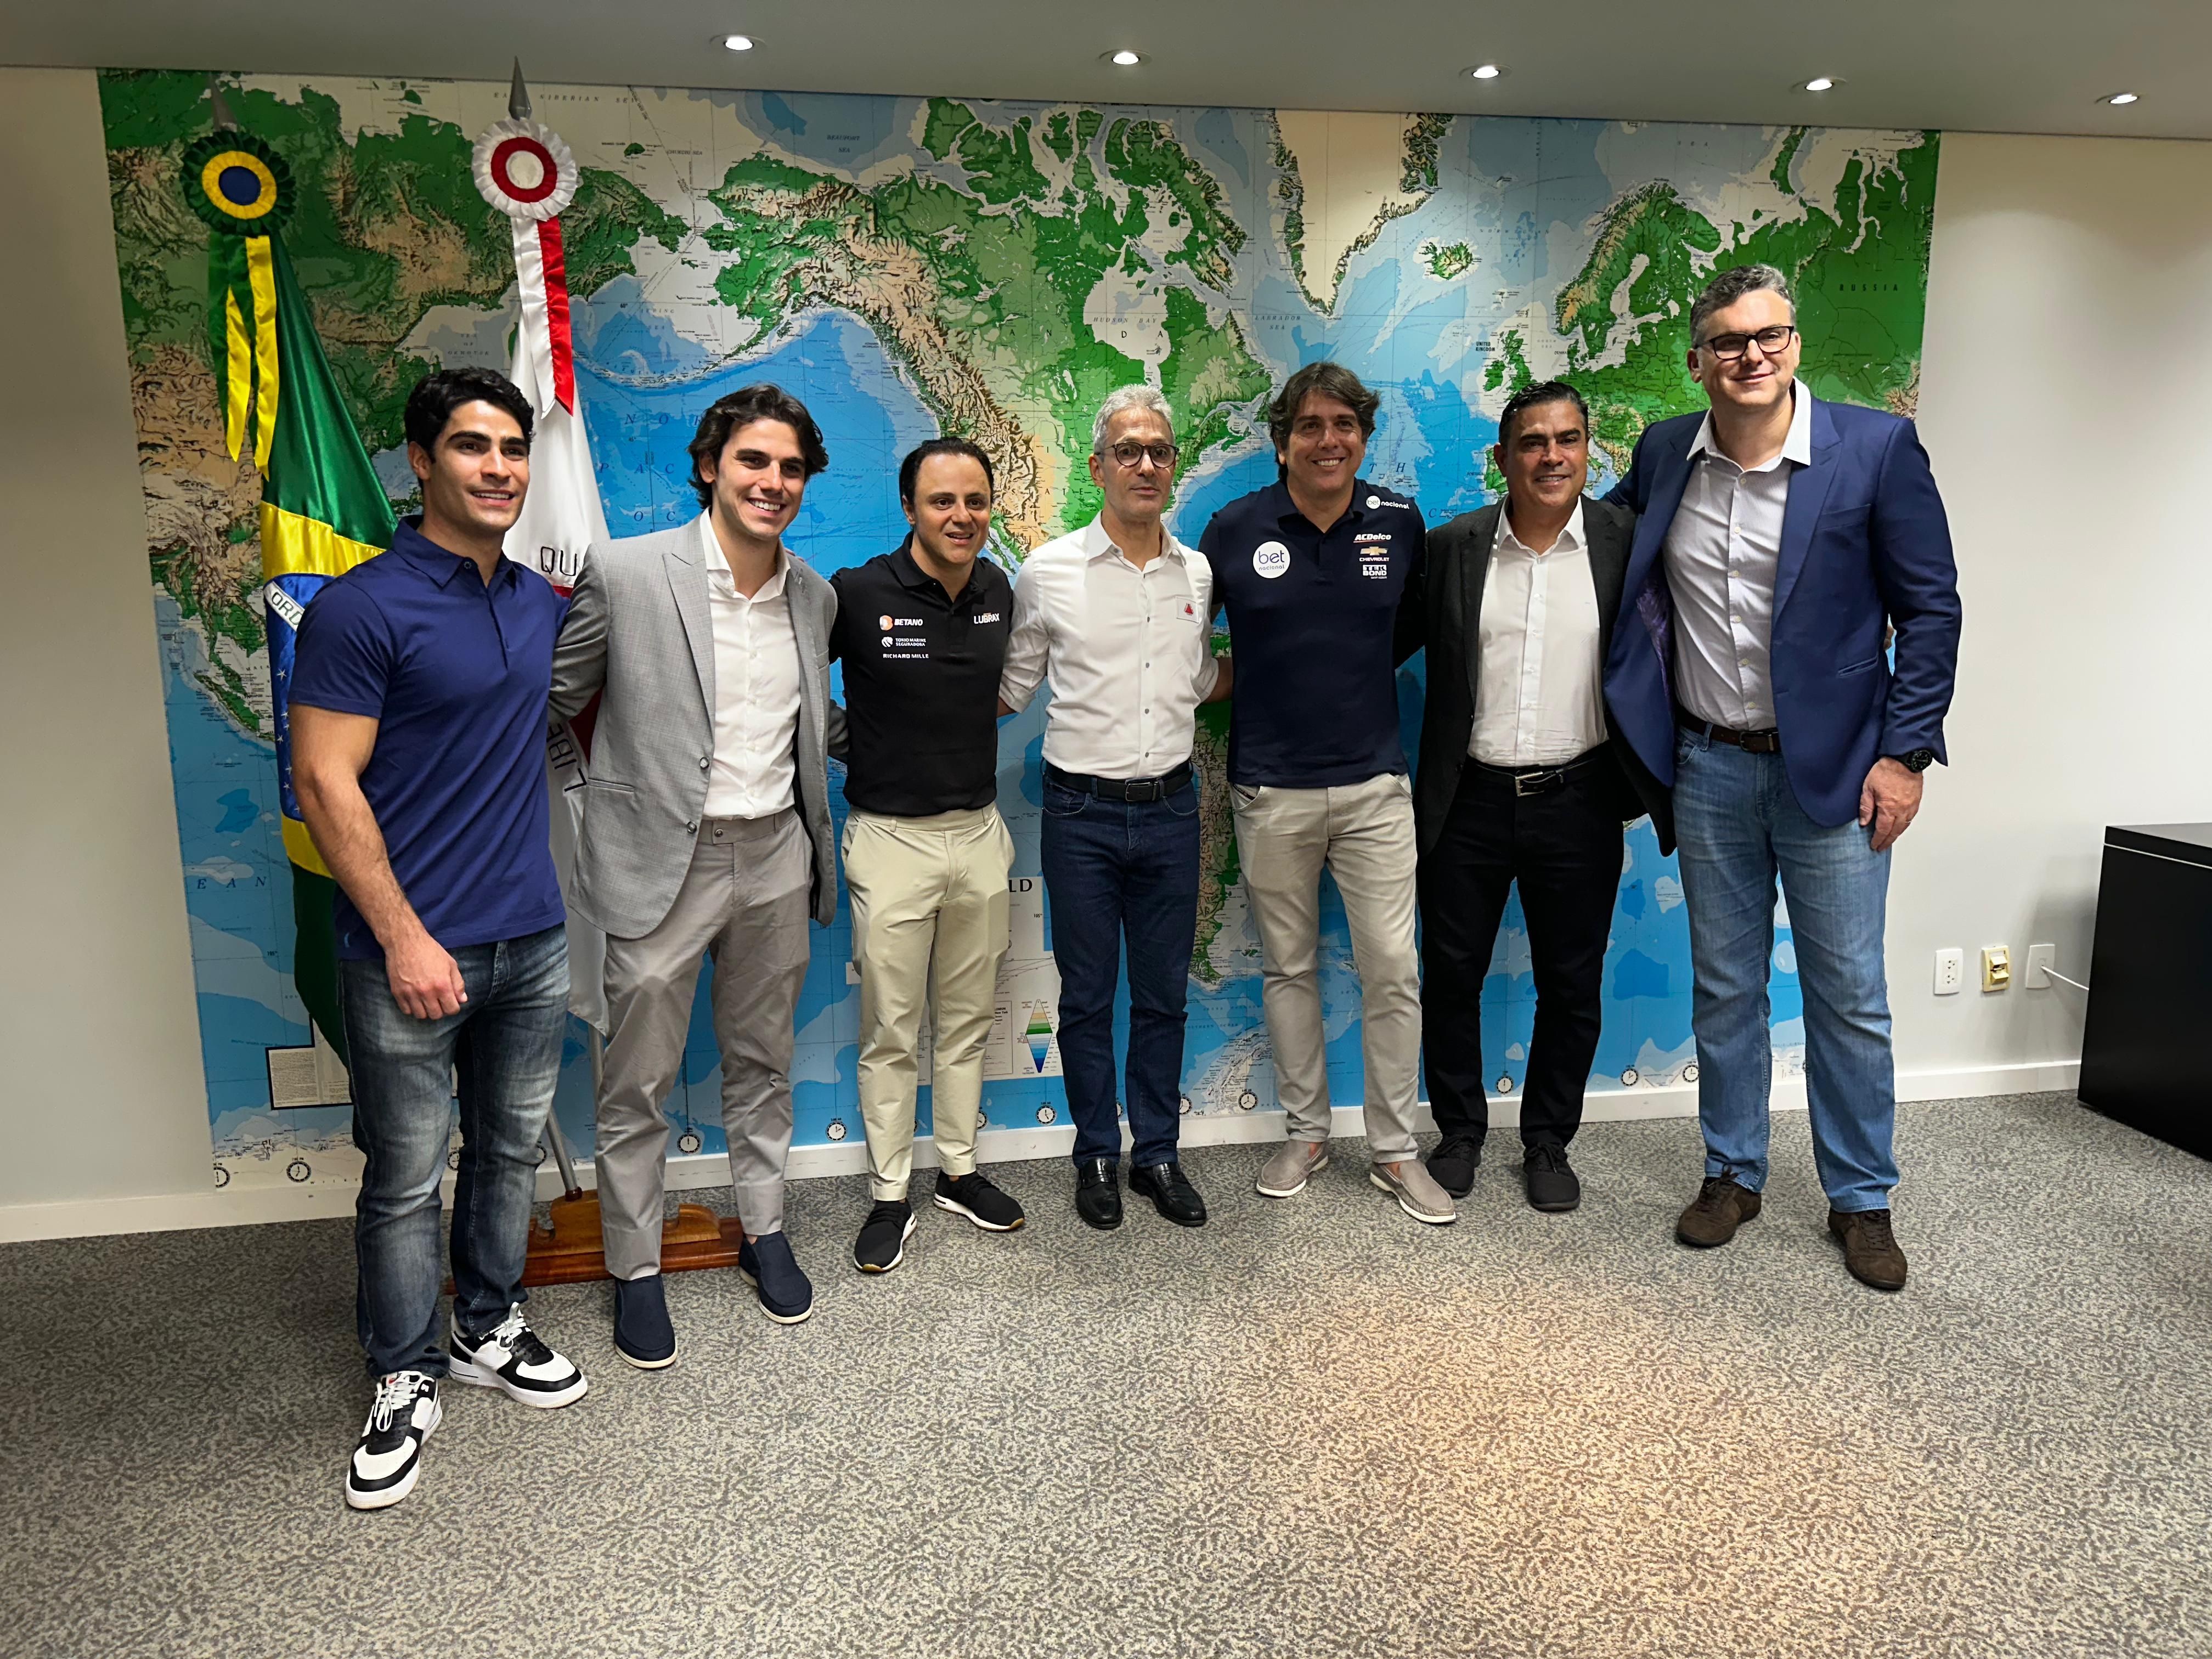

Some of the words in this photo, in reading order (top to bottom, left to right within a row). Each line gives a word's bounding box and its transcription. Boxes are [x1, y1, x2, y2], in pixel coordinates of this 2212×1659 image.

[539, 93, 600, 102] SIBERIAN
[741, 187, 823, 199] UNITED
[1839, 284, 1898, 292] RUSSIA
[1380, 500, 1410, 510] nacional
[1354, 533, 1392, 541] ACDelco
[540, 546, 577, 577] QU
[1258, 550, 1285, 565] bet
[272, 591, 303, 625] ORD
[894, 618, 923, 627] BETANO
[973, 613, 1000, 624] LUBRAX
[546, 723, 587, 792] LIBE
